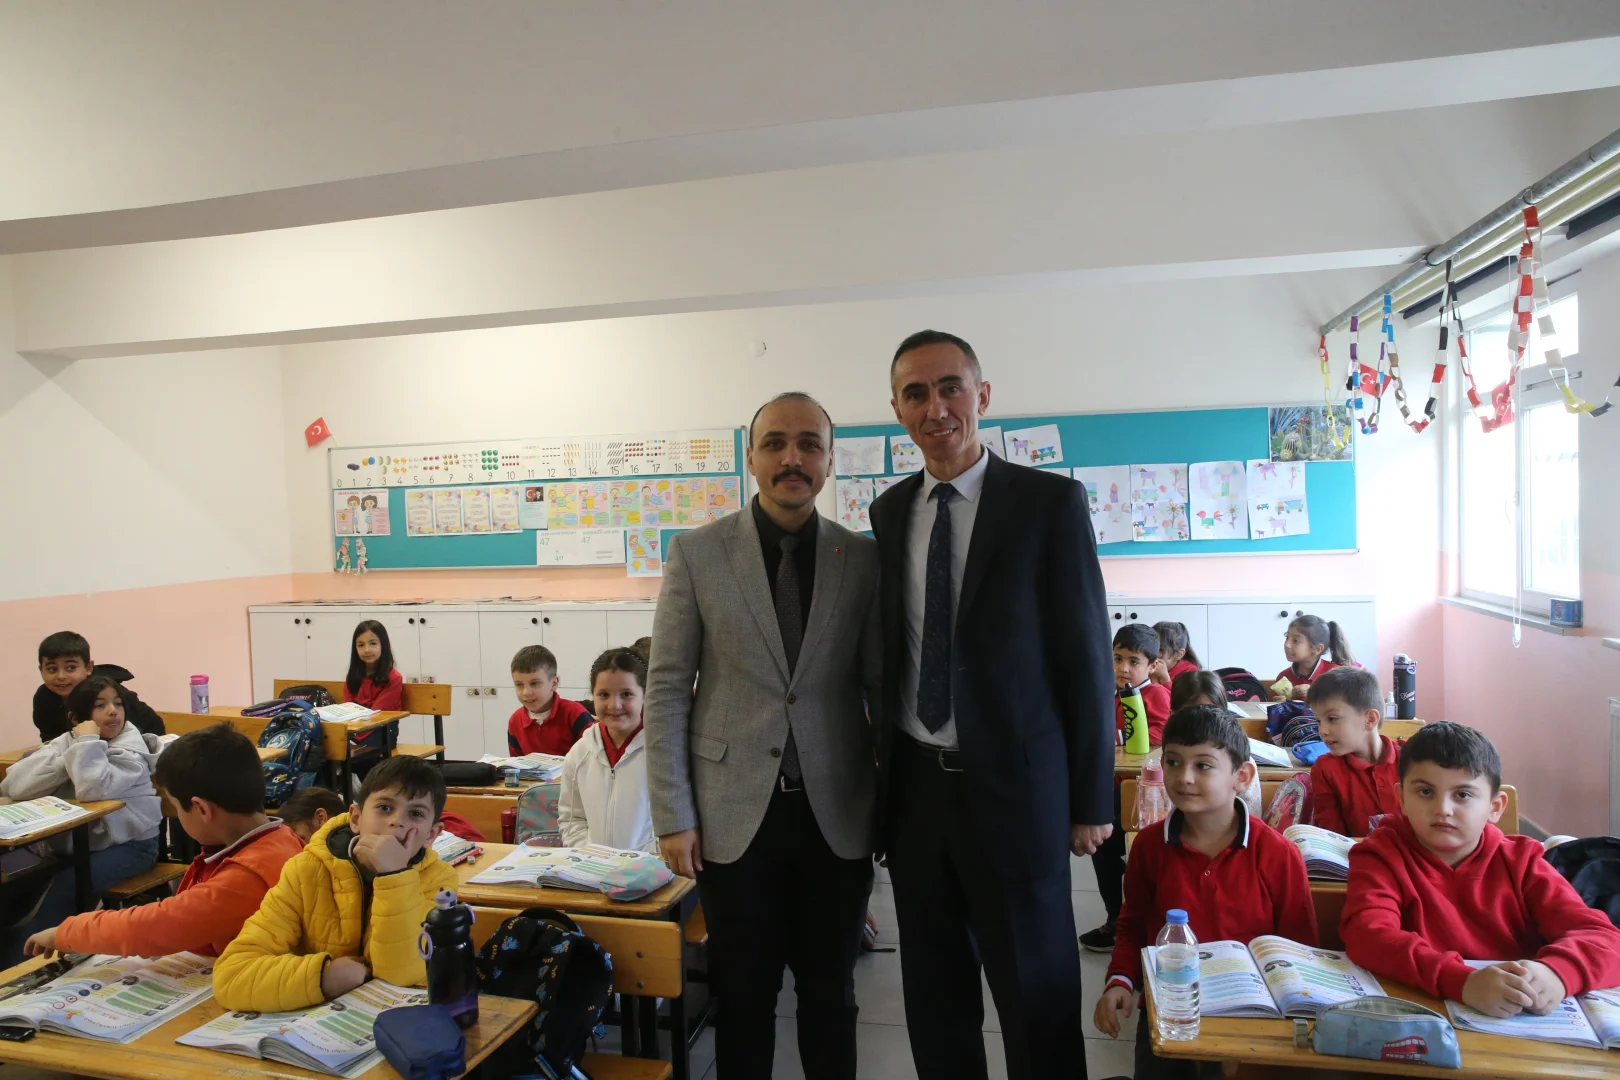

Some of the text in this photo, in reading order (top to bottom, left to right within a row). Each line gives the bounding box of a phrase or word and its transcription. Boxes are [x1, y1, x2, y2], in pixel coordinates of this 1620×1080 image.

[336, 460, 730, 488] 0 1 2 3 4 5 6 7 8 9 10 11 12 13 14 15 16 17 18 19 20
[540, 538, 550, 546] 47
